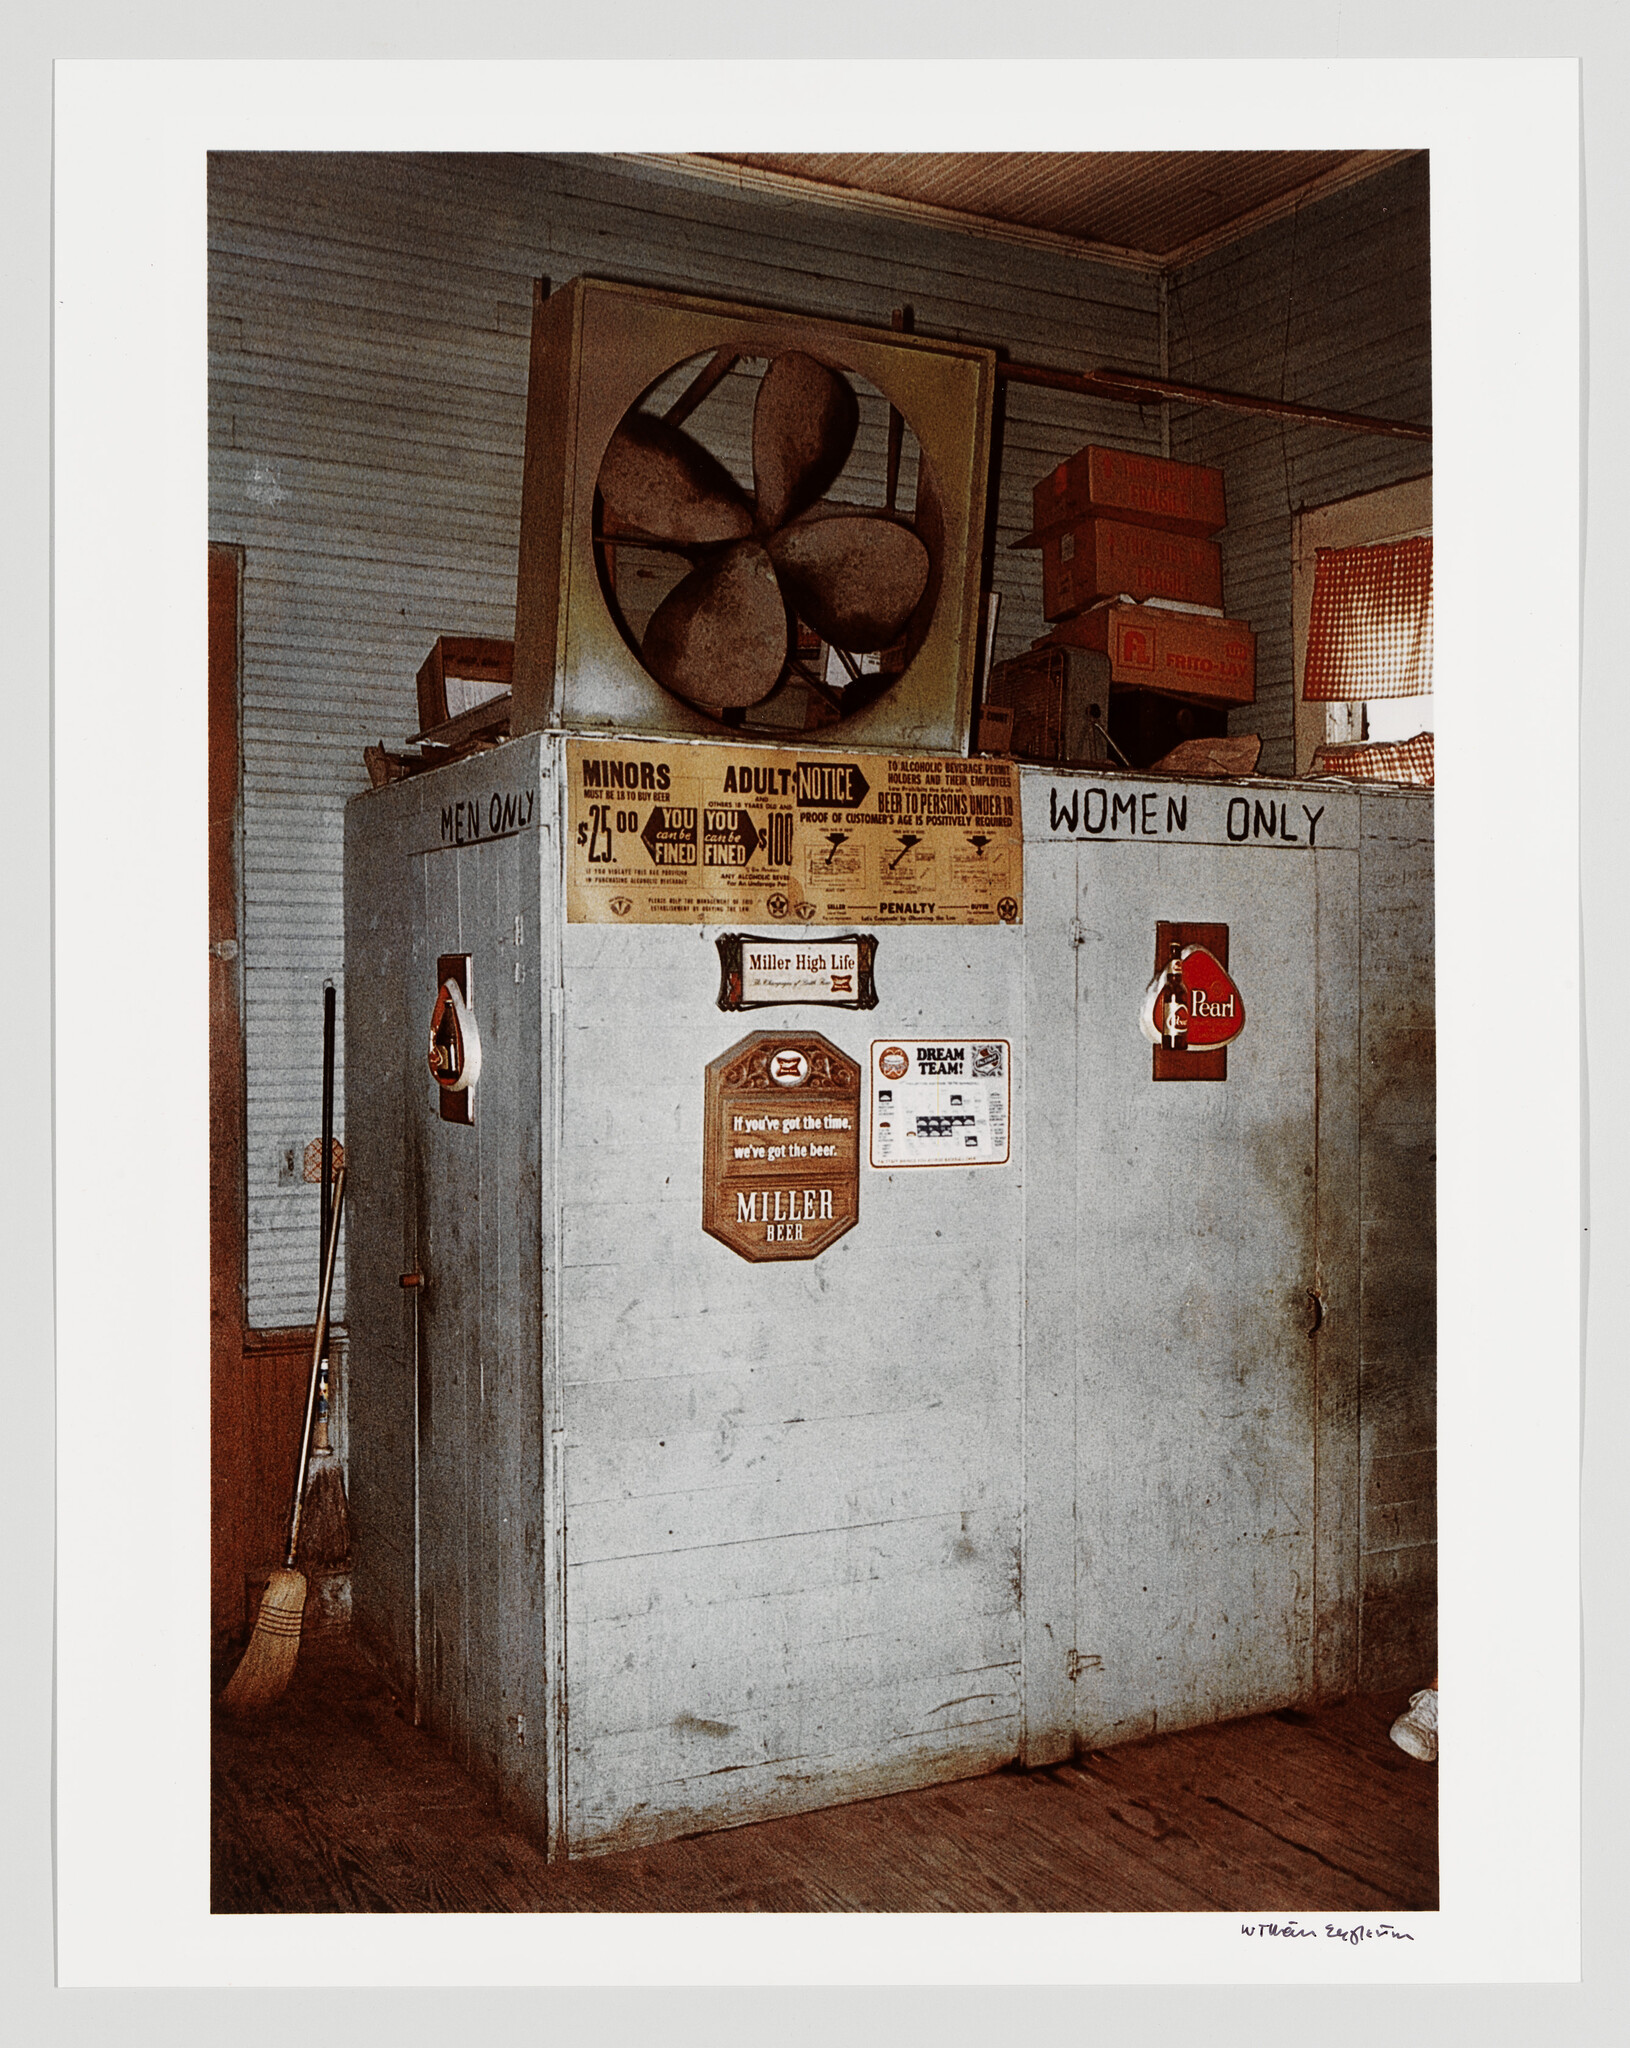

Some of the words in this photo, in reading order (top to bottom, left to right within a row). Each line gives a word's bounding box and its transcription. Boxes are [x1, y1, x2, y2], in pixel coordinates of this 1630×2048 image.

[1166, 653, 1248, 677] FRITO-LAY
[582, 759, 671, 790] MINORS
[888, 761, 898, 772] TO
[901, 762, 942, 773] ALCOHOLIC
[945, 763, 982, 774] BEVERAGE
[985, 764, 1010, 775] PERMIT
[799, 767, 854, 800] NOTICE
[888, 773, 921, 785] HOLDERS
[925, 774, 941, 785] AND
[945, 775, 967, 786] THEIR
[971, 775, 1012, 787] EMPLOYEES
[584, 789, 603, 800] MUST
[606, 790, 615, 800] BE
[617, 791, 625, 800] 18
[627, 791, 636, 801] TO
[638, 791, 651, 802] BUY
[653, 791, 670, 802] BEER
[878, 792, 902, 814] BEER
[906, 793, 919, 815] TO
[921, 793, 968, 816] PERSONS
[970, 794, 1002, 816] UNDER
[1004, 796, 1014, 816] 18
[441, 801, 480, 844] MEN
[489, 789, 535, 834] ONLY
[662, 808, 695, 829] YOU
[706, 811, 738, 831] YOU
[801, 812, 828, 823] PROOF
[832, 813, 842, 823] OF
[846, 813, 894, 825] CUSTOMER'S
[897, 815, 912, 825] AGE
[915, 815, 923, 826] IS
[926, 815, 971, 827] POSITIVELY
[975, 816, 1013, 828] REQUIRED
[1050, 788, 1187, 835] WOMEN
[1227, 796, 1325, 846] ONLY
[656, 831, 677, 840] can
[679, 829, 692, 841] be
[705, 833, 727, 842] can
[728, 830, 742, 842] be
[758, 812, 794, 866] $100
[655, 843, 697, 864] FINED
[705, 844, 746, 865] FINED
[880, 902, 936, 914] PENALTY
[750, 954, 791, 970] Miller
[796, 954, 827, 973] High
[831, 954, 855, 970] Life
[1192, 990, 1234, 1017] Pearl
[916, 1048, 964, 1061] DREAM
[918, 1062, 963, 1075] TEAM!
[733, 1116, 743, 1131] If
[745, 1117, 779, 1133] you've
[782, 1117, 801, 1133] got
[803, 1115, 822, 1130] the
[824, 1114, 852, 1131] time,
[734, 1145, 765, 1159] we've
[767, 1145, 786, 1161] got
[789, 1143, 807, 1158] the
[809, 1143, 837, 1157] beer.
[736, 1189, 834, 1223] MILLER
[766, 1223, 803, 1242] BEER
